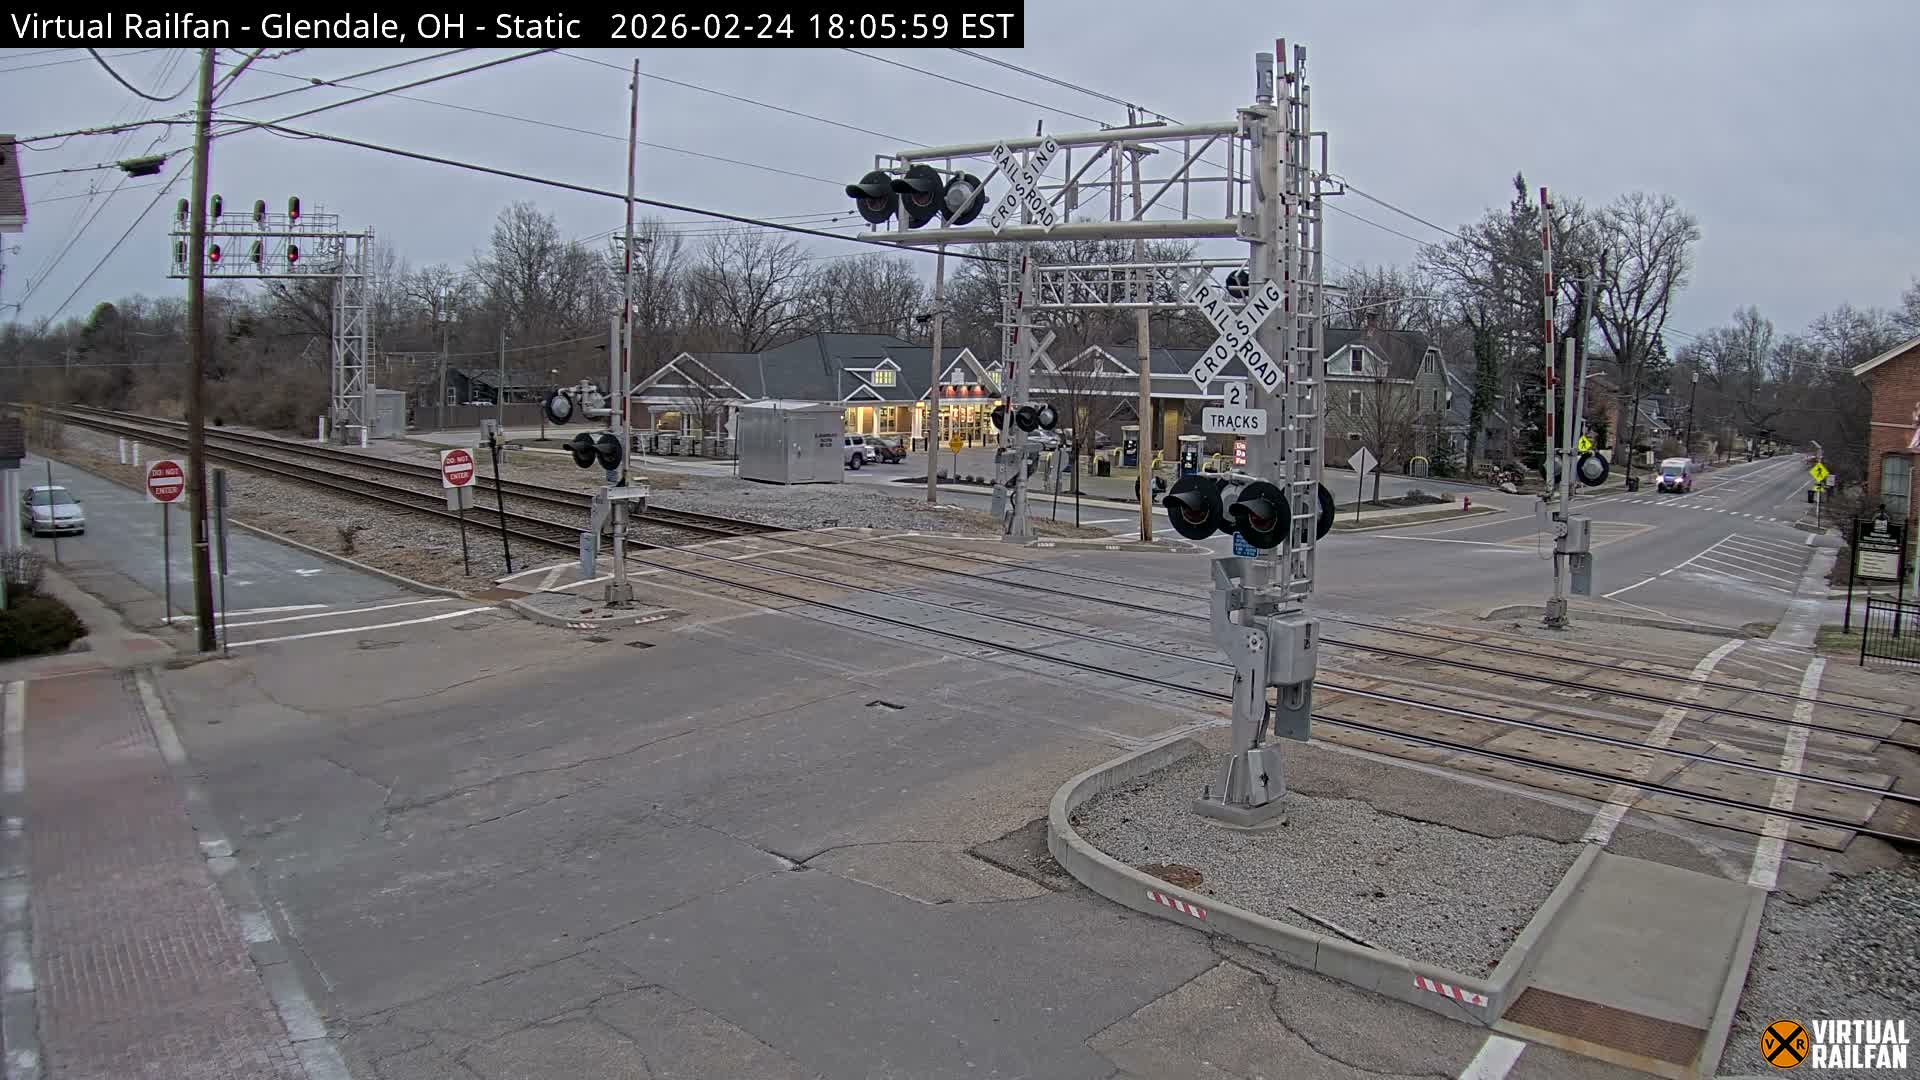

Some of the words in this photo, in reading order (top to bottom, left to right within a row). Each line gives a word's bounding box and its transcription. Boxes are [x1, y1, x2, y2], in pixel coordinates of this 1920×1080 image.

[991, 140, 1055, 229] CROSSING
[1194, 286, 1280, 384] CROSSING
[1230, 388, 1240, 405] 2
[1210, 414, 1259, 429] TRACKS
[457, 455, 469, 463] NOT
[152, 469, 161, 477] DO
[450, 472, 469, 480] ENTER
[156, 487, 178, 495] ENTER
